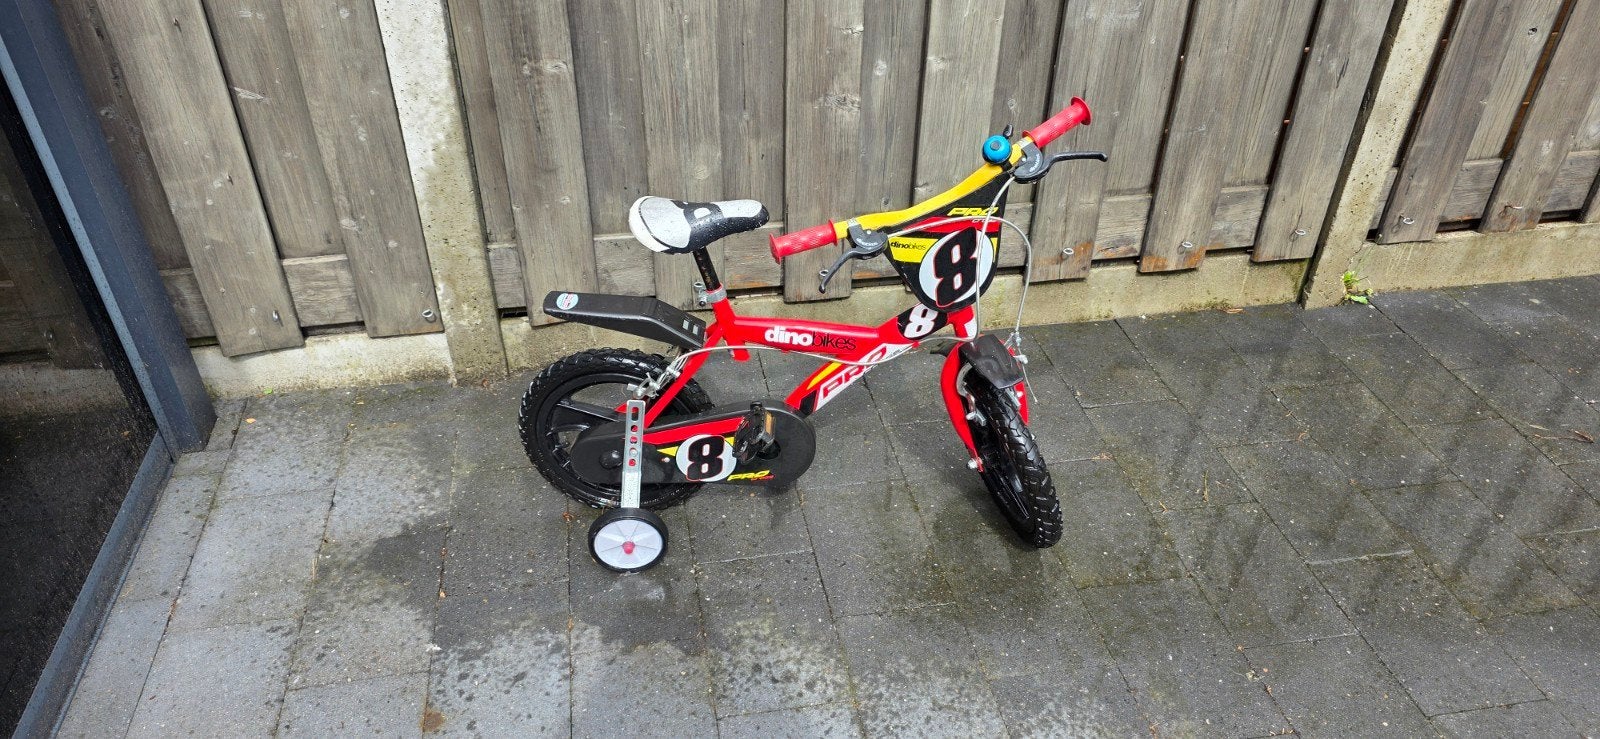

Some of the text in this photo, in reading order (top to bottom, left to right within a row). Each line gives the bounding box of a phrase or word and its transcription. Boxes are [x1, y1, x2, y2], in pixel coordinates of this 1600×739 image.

[946, 206, 999, 216] PRO
[890, 241, 927, 250] dinobikes
[933, 226, 978, 308] 8
[904, 304, 938, 338] 8
[765, 326, 857, 350] dinobikes
[821, 346, 888, 398] PRO
[686, 434, 725, 481] 8
[727, 470, 770, 481] PRO
